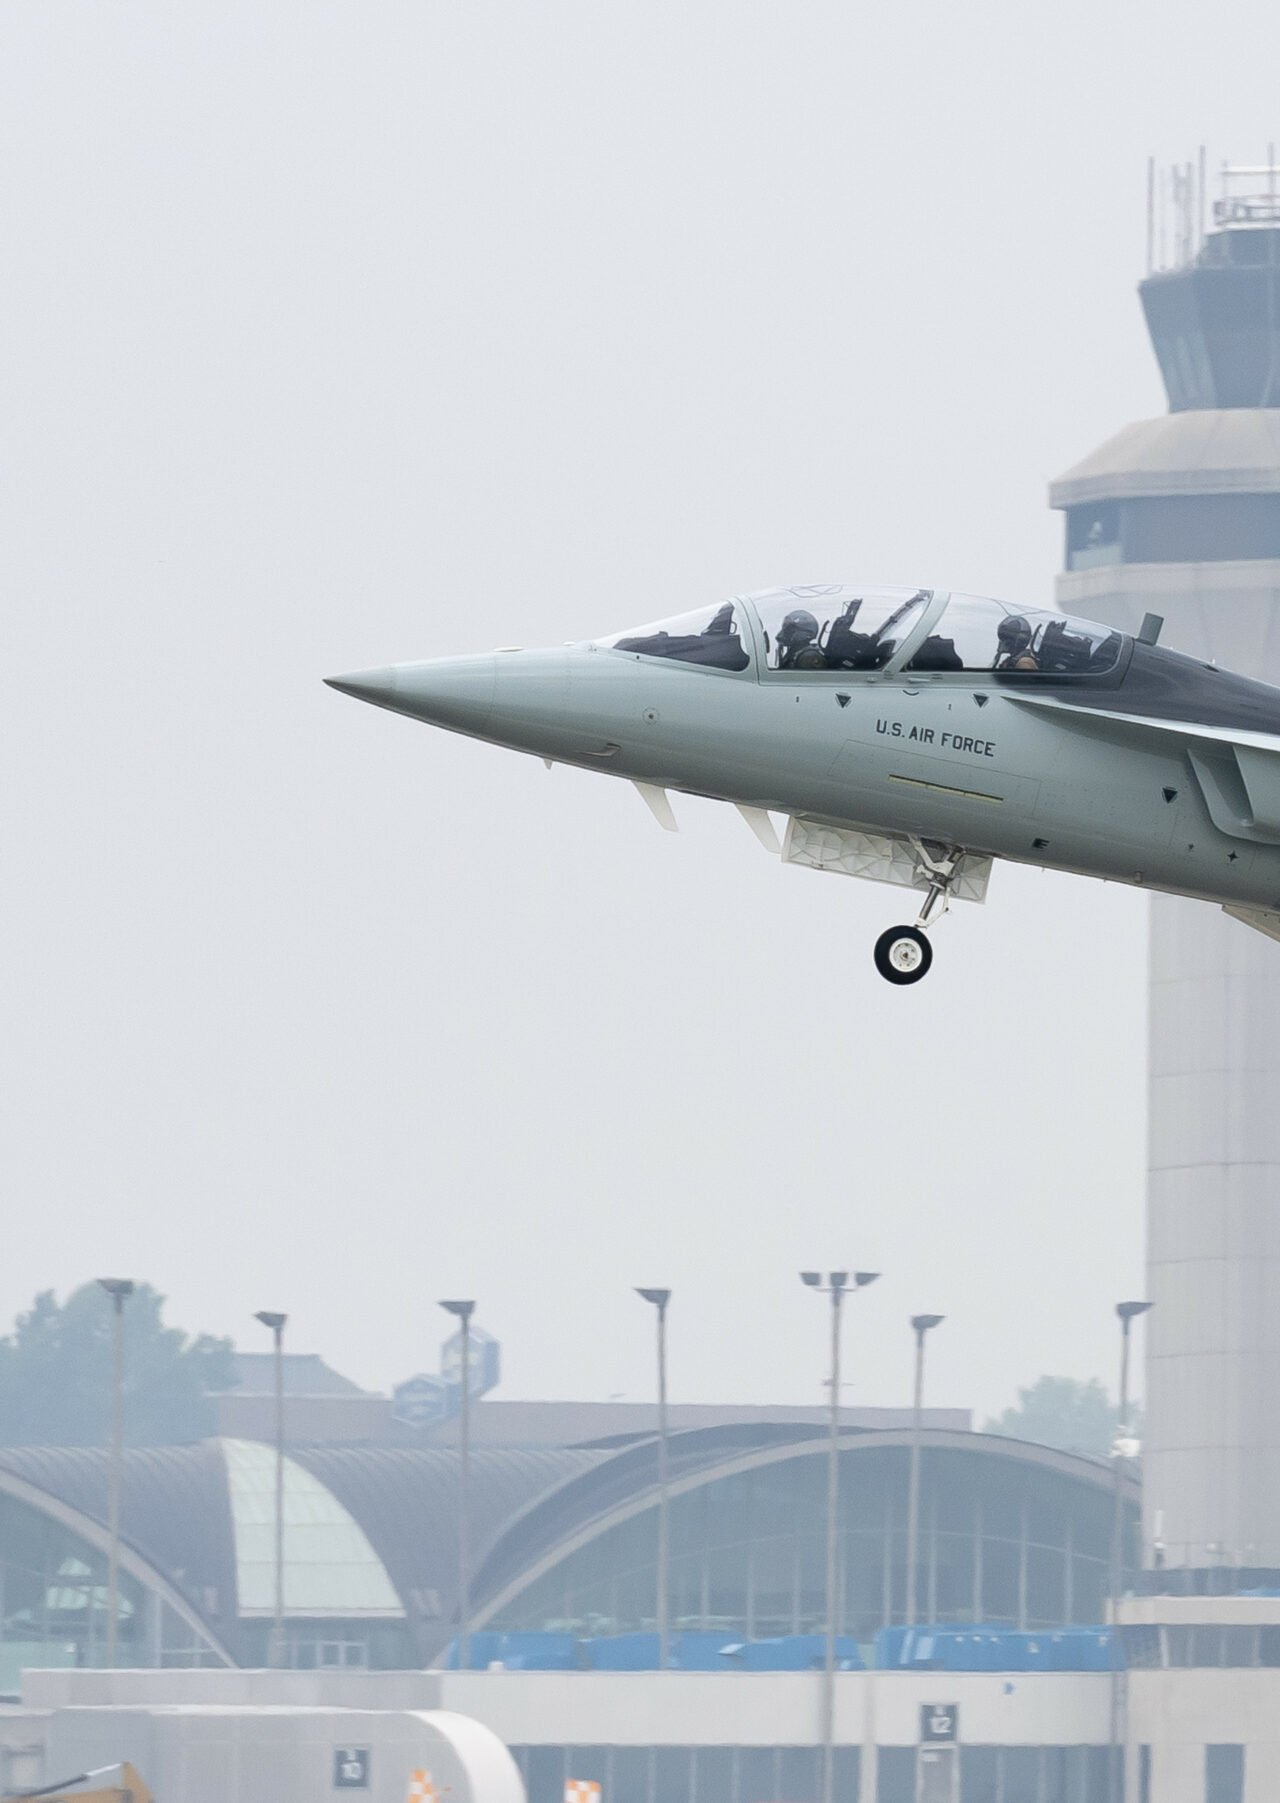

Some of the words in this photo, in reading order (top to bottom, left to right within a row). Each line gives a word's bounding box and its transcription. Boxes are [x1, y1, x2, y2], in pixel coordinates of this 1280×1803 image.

[876, 719, 905, 738] U.S.
[909, 726, 935, 744] AIR
[941, 732, 997, 757] FORCE
